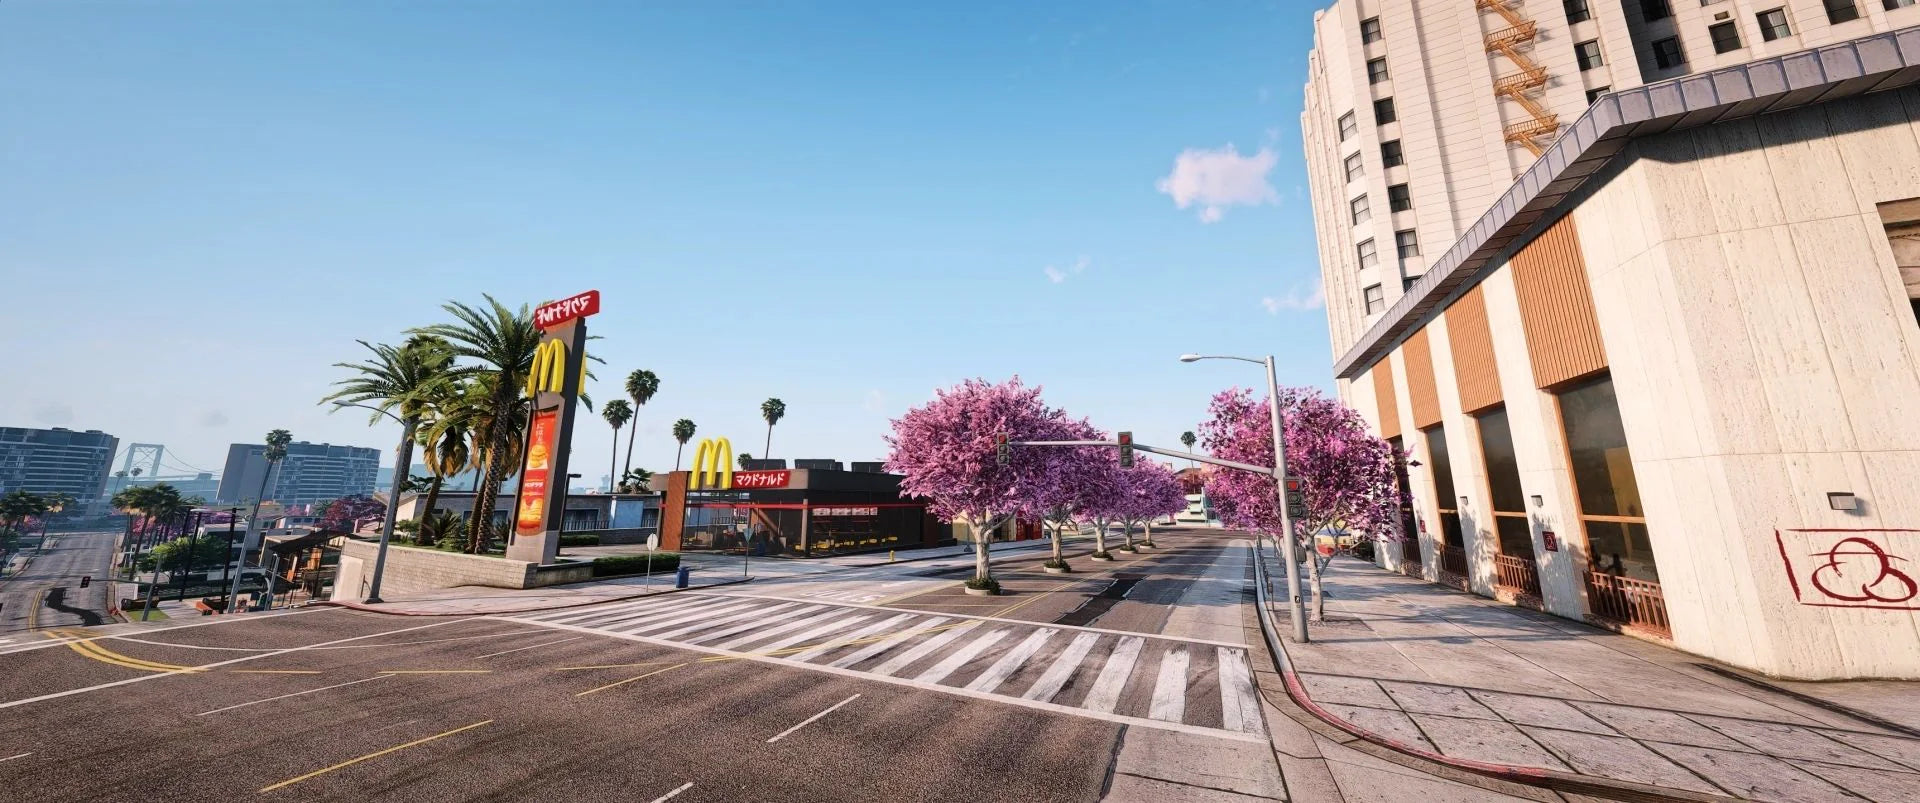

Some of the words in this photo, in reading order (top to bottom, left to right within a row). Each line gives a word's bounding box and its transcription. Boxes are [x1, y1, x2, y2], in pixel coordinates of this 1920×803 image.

[527, 338, 564, 398] M
[690, 437, 732, 490] M
[736, 473, 785, 486] マクドナルド
